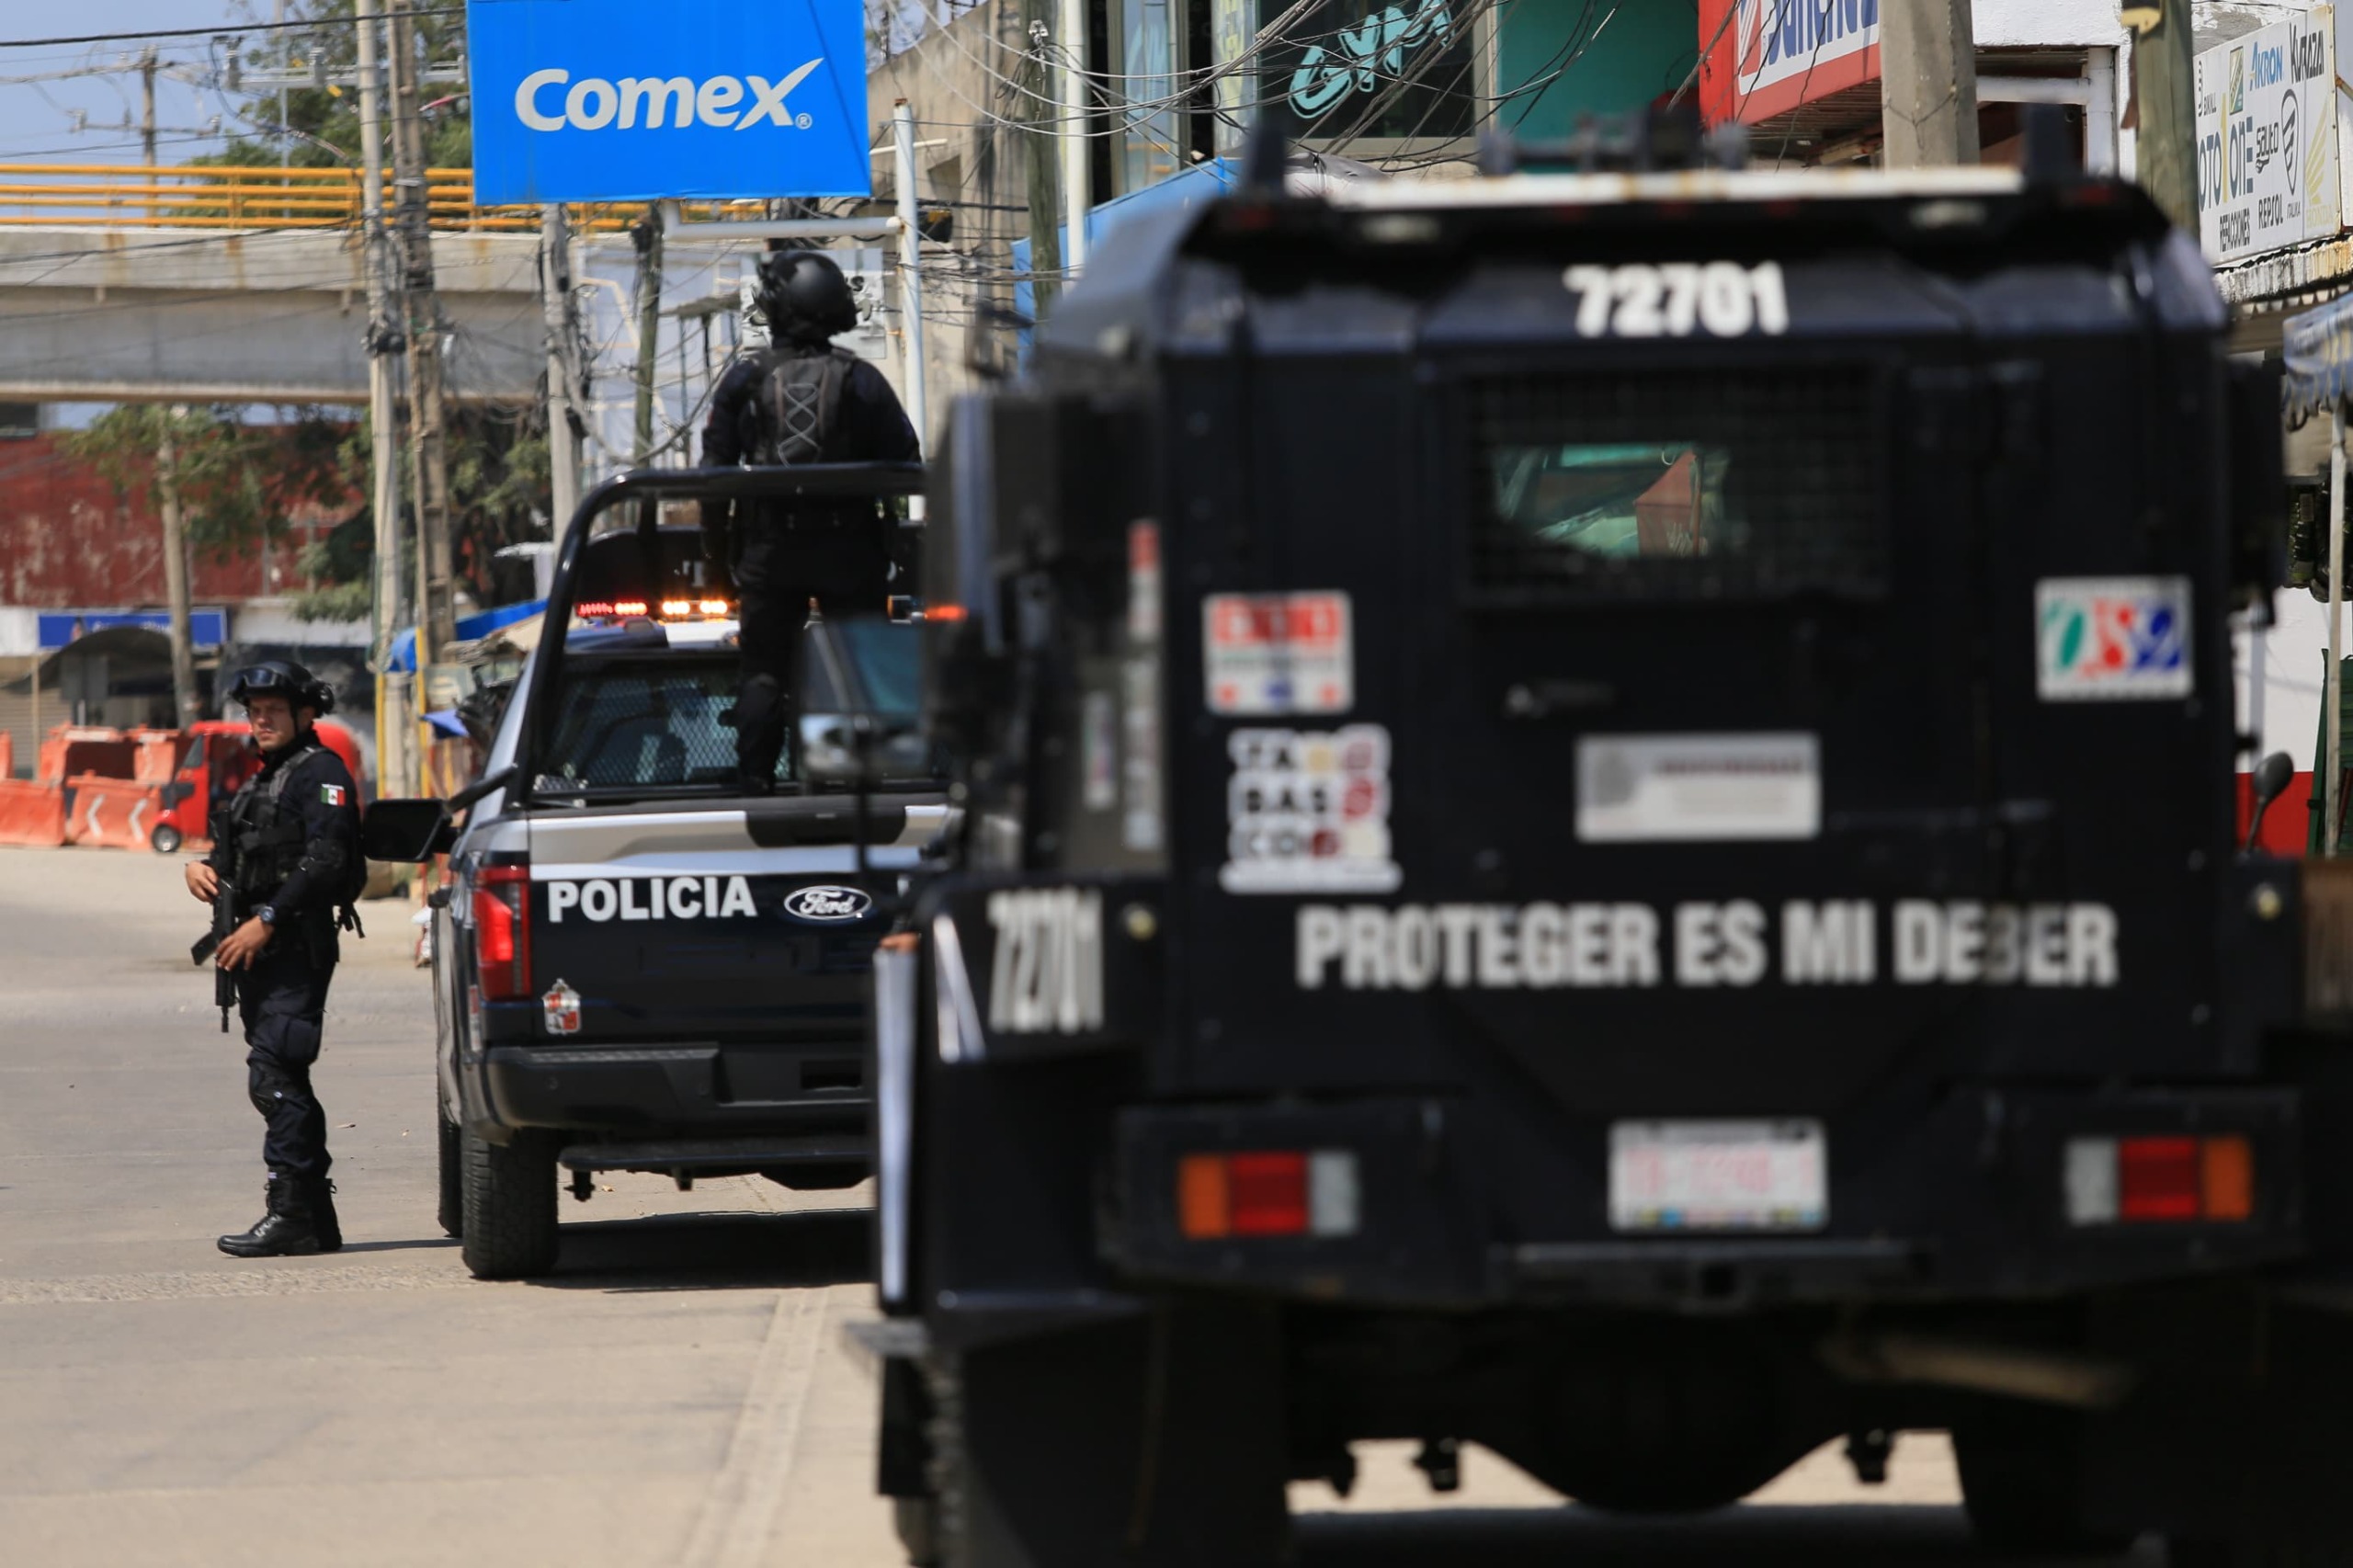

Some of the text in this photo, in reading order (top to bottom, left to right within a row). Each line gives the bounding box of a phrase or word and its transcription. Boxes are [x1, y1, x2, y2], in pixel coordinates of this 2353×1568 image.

[2249, 41, 2283, 91] AKRON
[515, 57, 825, 131] Comex
[2258, 193, 2284, 230] REPSOL
[1564, 260, 1790, 337] 72701
[549, 876, 757, 923] POLICIA
[800, 889, 855, 915] Ford
[1298, 901, 2119, 989] PROTEGER ES MI DEBER
